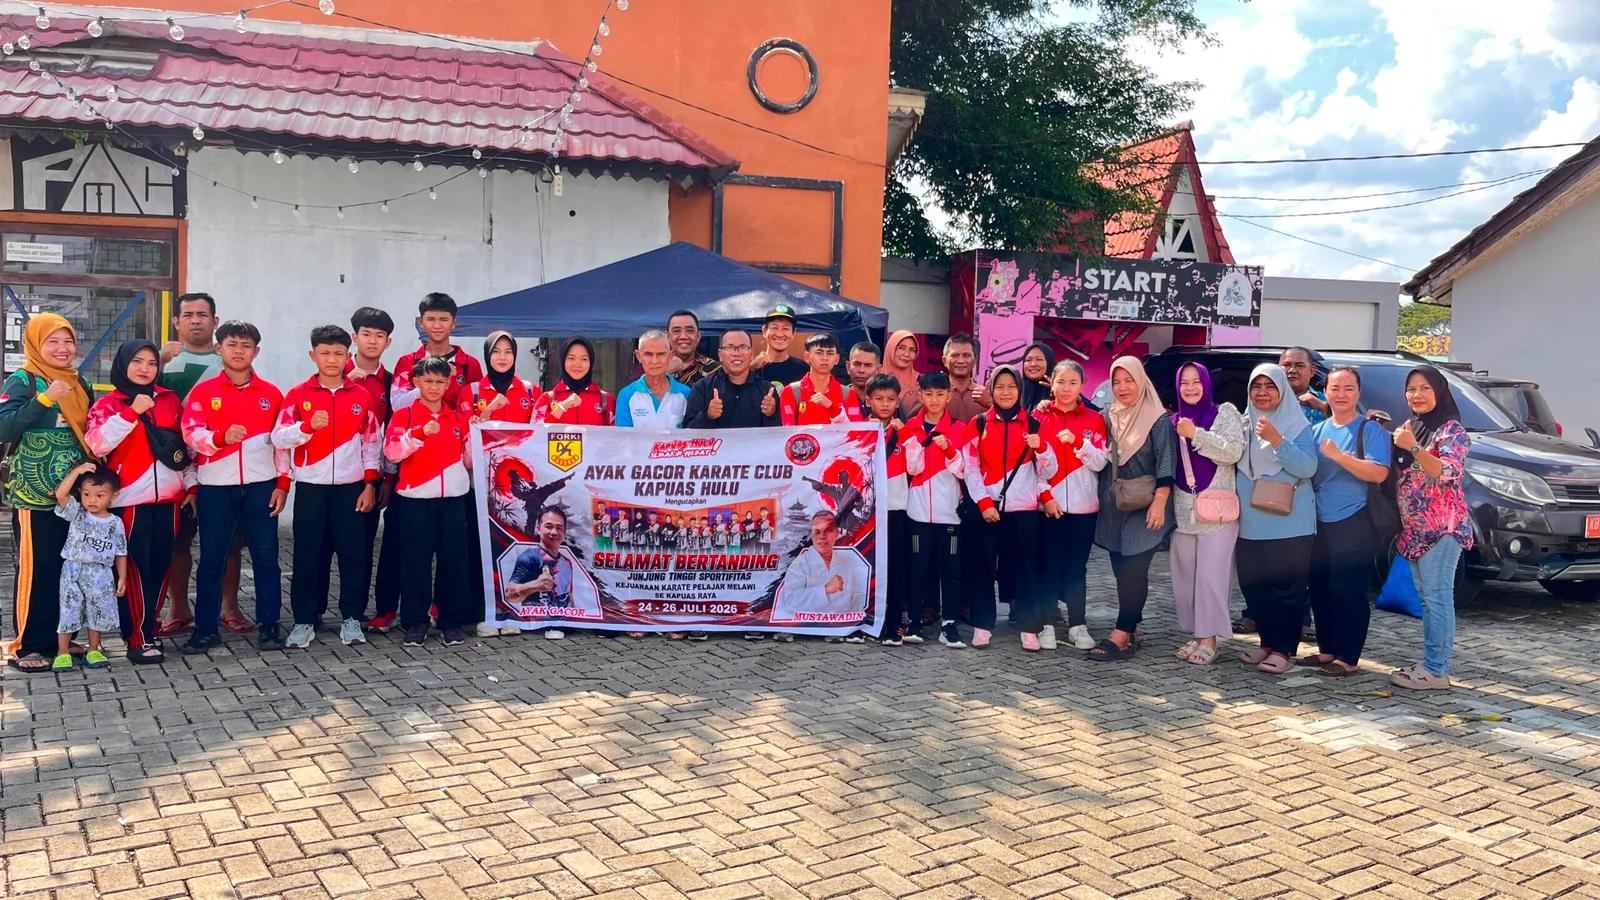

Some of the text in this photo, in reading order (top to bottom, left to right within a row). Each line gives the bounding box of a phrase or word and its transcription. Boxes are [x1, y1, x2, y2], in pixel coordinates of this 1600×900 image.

[1083, 268, 1167, 293] START
[653, 438, 716, 451] KAPUAS HULU
[650, 450, 683, 459] SEMAKIN
[584, 465, 794, 480] AYAK GACOR KARATE CLUB
[634, 481, 740, 497] KAPUAS HULU
[80, 532, 113, 553] Jogja
[593, 552, 779, 571] SELAMAT BERTANDING
[627, 572, 752, 581] JUNJUNG TINGGI SPORTIFITAS
[615, 582, 660, 591] KEJUARAAN
[692, 583, 725, 591] PELAJAR
[519, 606, 586, 617] AYAK GACOR
[638, 602, 652, 612] 24
[662, 603, 677, 613] 26
[679, 604, 706, 613] JULI
[709, 604, 738, 614] 2026
[793, 612, 864, 621] MUSTAWADIN
